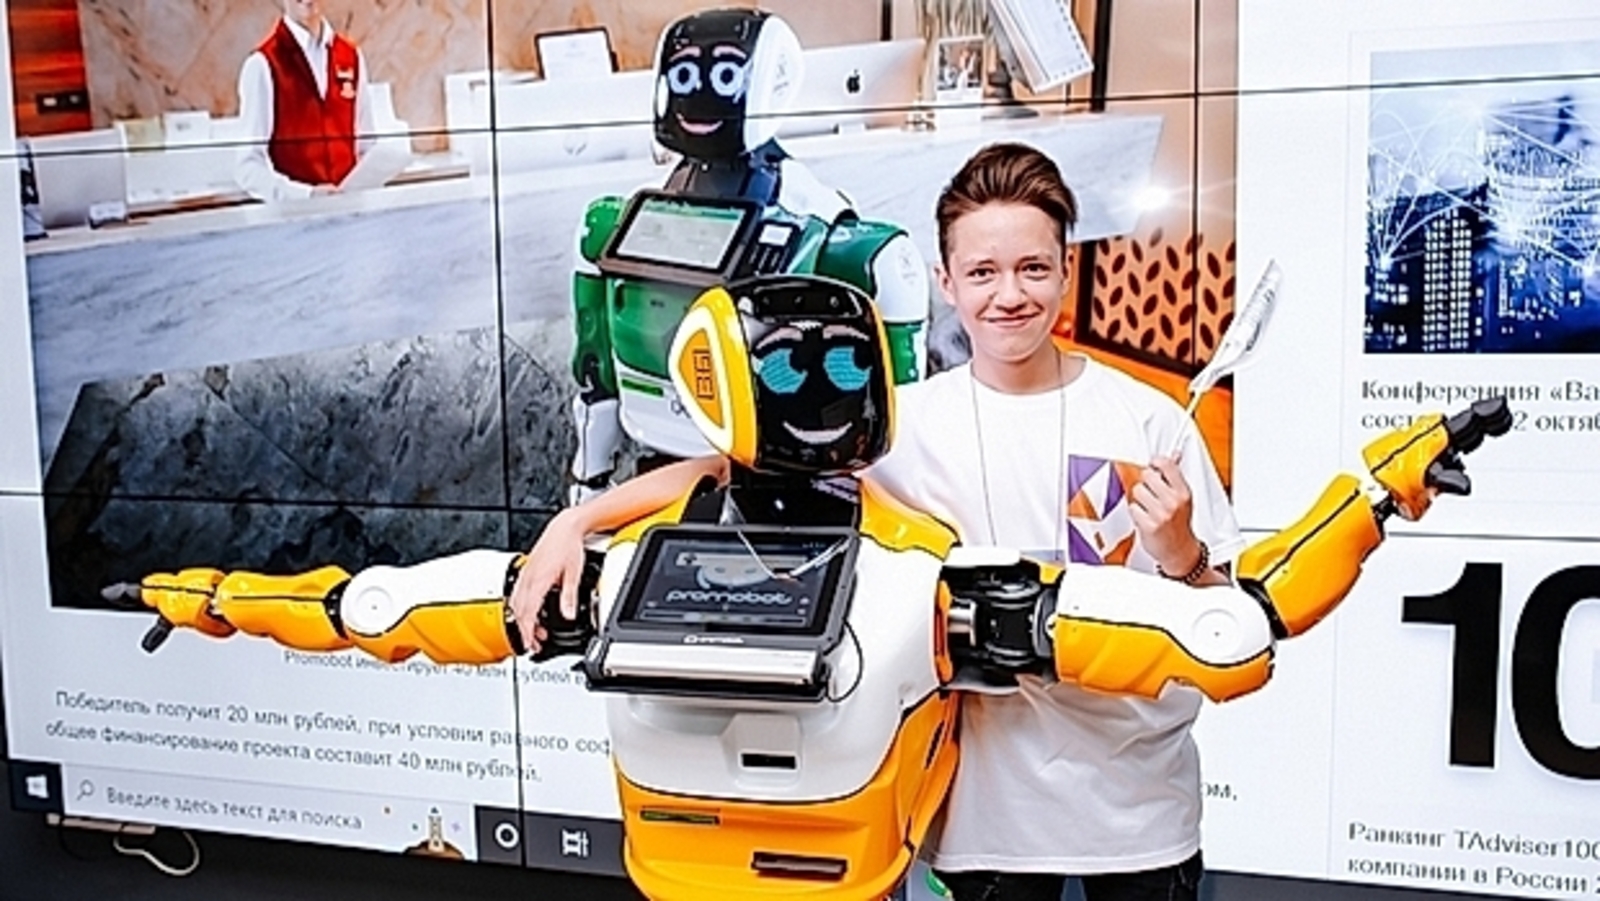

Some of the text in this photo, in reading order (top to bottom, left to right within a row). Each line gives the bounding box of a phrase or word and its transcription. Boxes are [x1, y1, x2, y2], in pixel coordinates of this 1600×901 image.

[1361, 380, 1540, 405] Конференция
[665, 590, 793, 605] promobot
[284, 651, 352, 669] Promobot
[520, 666, 571, 684] ублей
[55, 690, 151, 715] Победитель
[156, 702, 221, 721] получит
[227, 705, 249, 723] 20
[254, 711, 288, 727] млн
[294, 713, 361, 734] рублей,
[368, 718, 401, 737] при
[407, 722, 484, 742] условии
[46, 720, 97, 740] общее
[101, 726, 239, 751] финансирование
[243, 740, 312, 760] проекта
[315, 746, 392, 767] составит
[397, 751, 421, 769] 40
[425, 758, 462, 772] млн
[106, 786, 363, 830] Введите здесь текст для поиска
[1348, 821, 1446, 848] Ранкинг
[1348, 858, 1466, 882] компании
[1474, 868, 1488, 884] в
[1496, 866, 1588, 893] России
